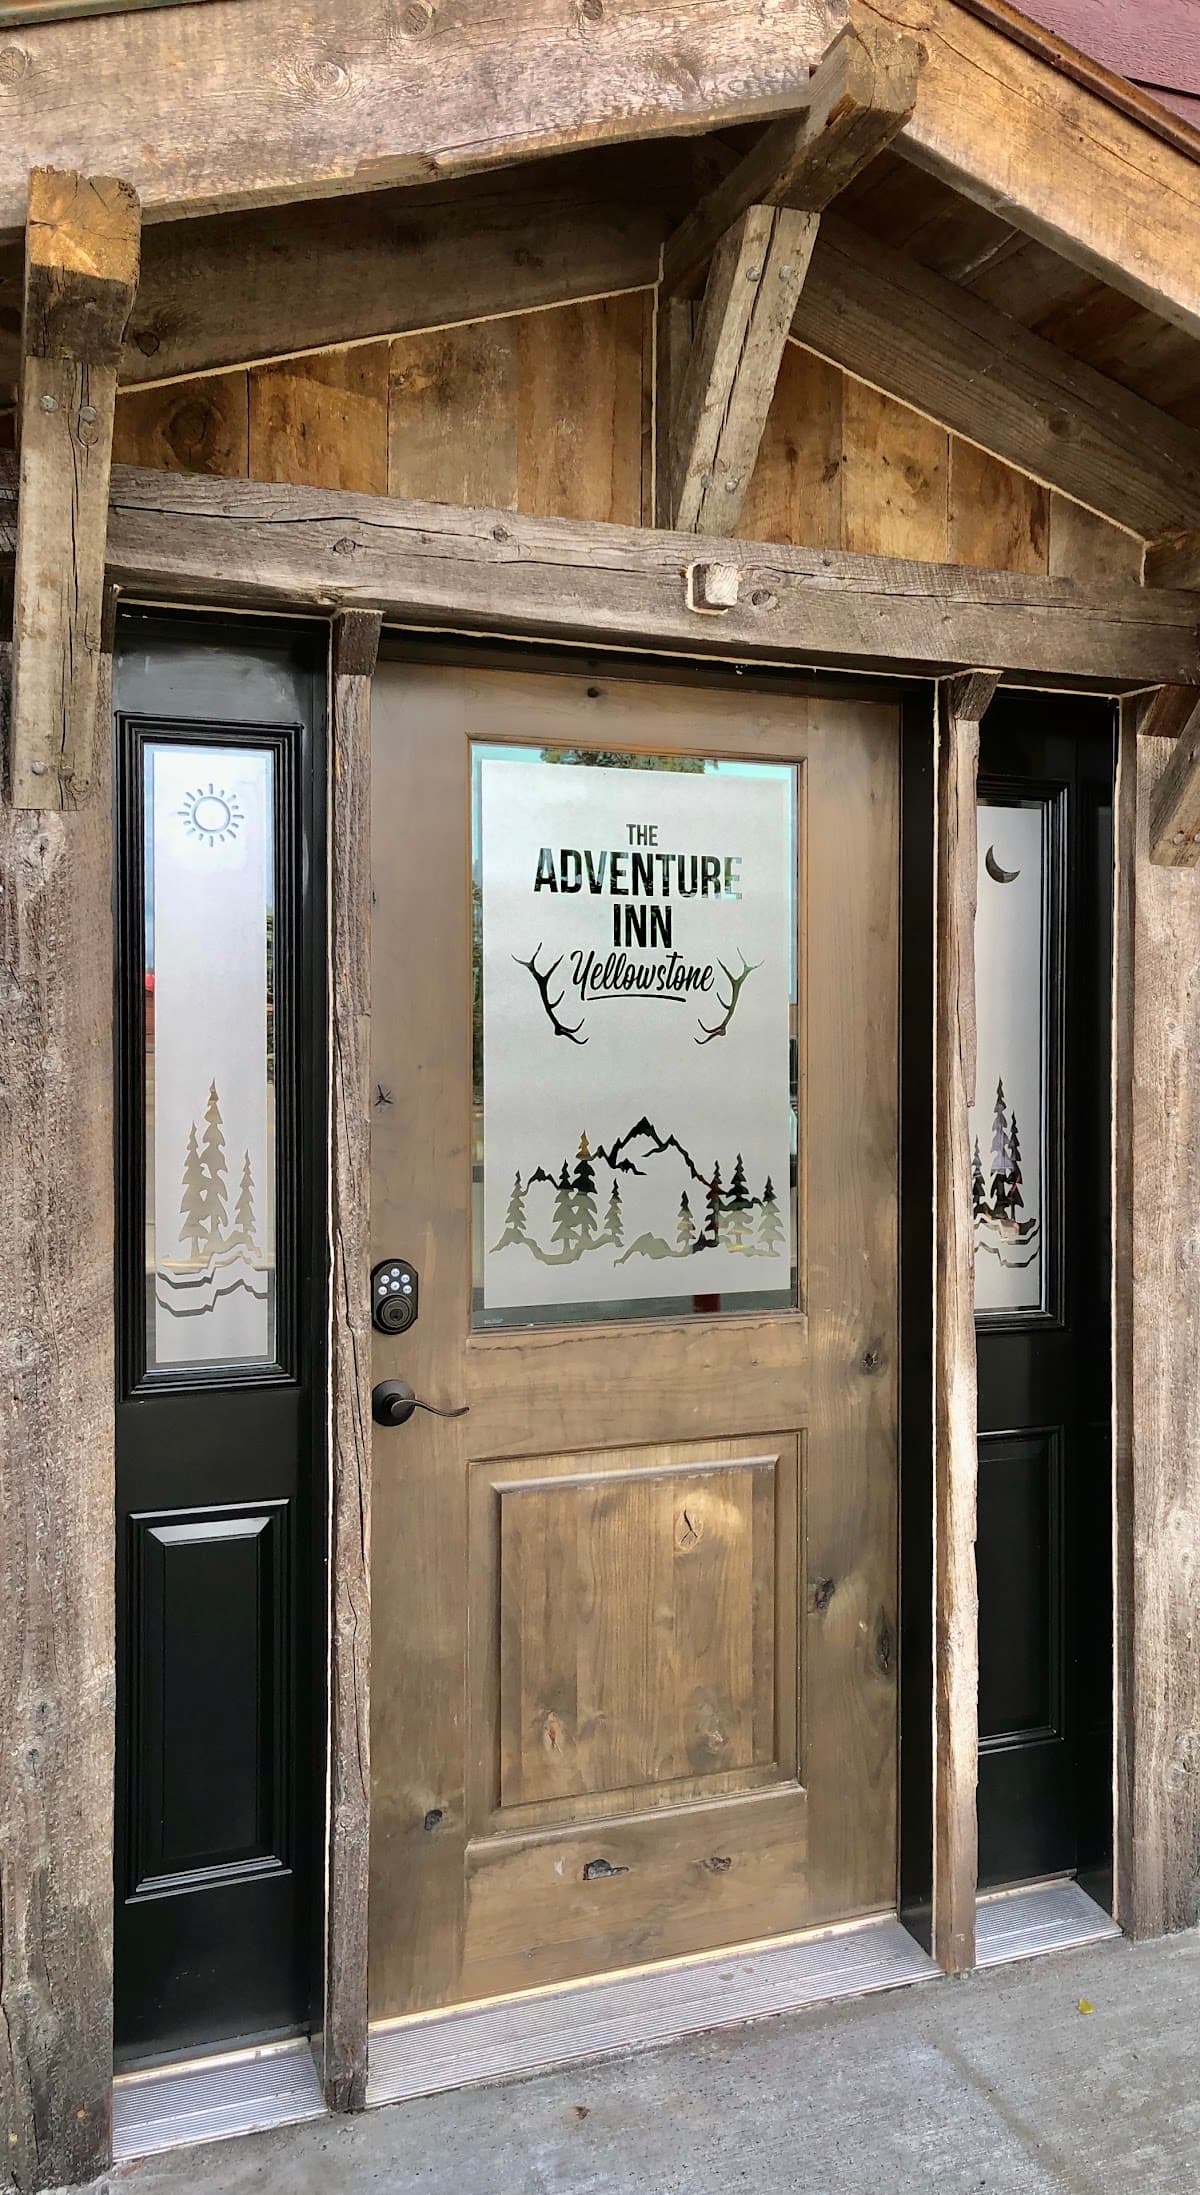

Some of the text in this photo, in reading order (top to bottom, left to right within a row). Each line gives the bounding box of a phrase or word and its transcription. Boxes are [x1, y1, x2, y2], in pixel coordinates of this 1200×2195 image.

[626, 824, 658, 846] THE
[534, 848, 742, 900] ADVENTURE
[613, 904, 672, 948] INN
[570, 950, 714, 1001] Yellowstone
